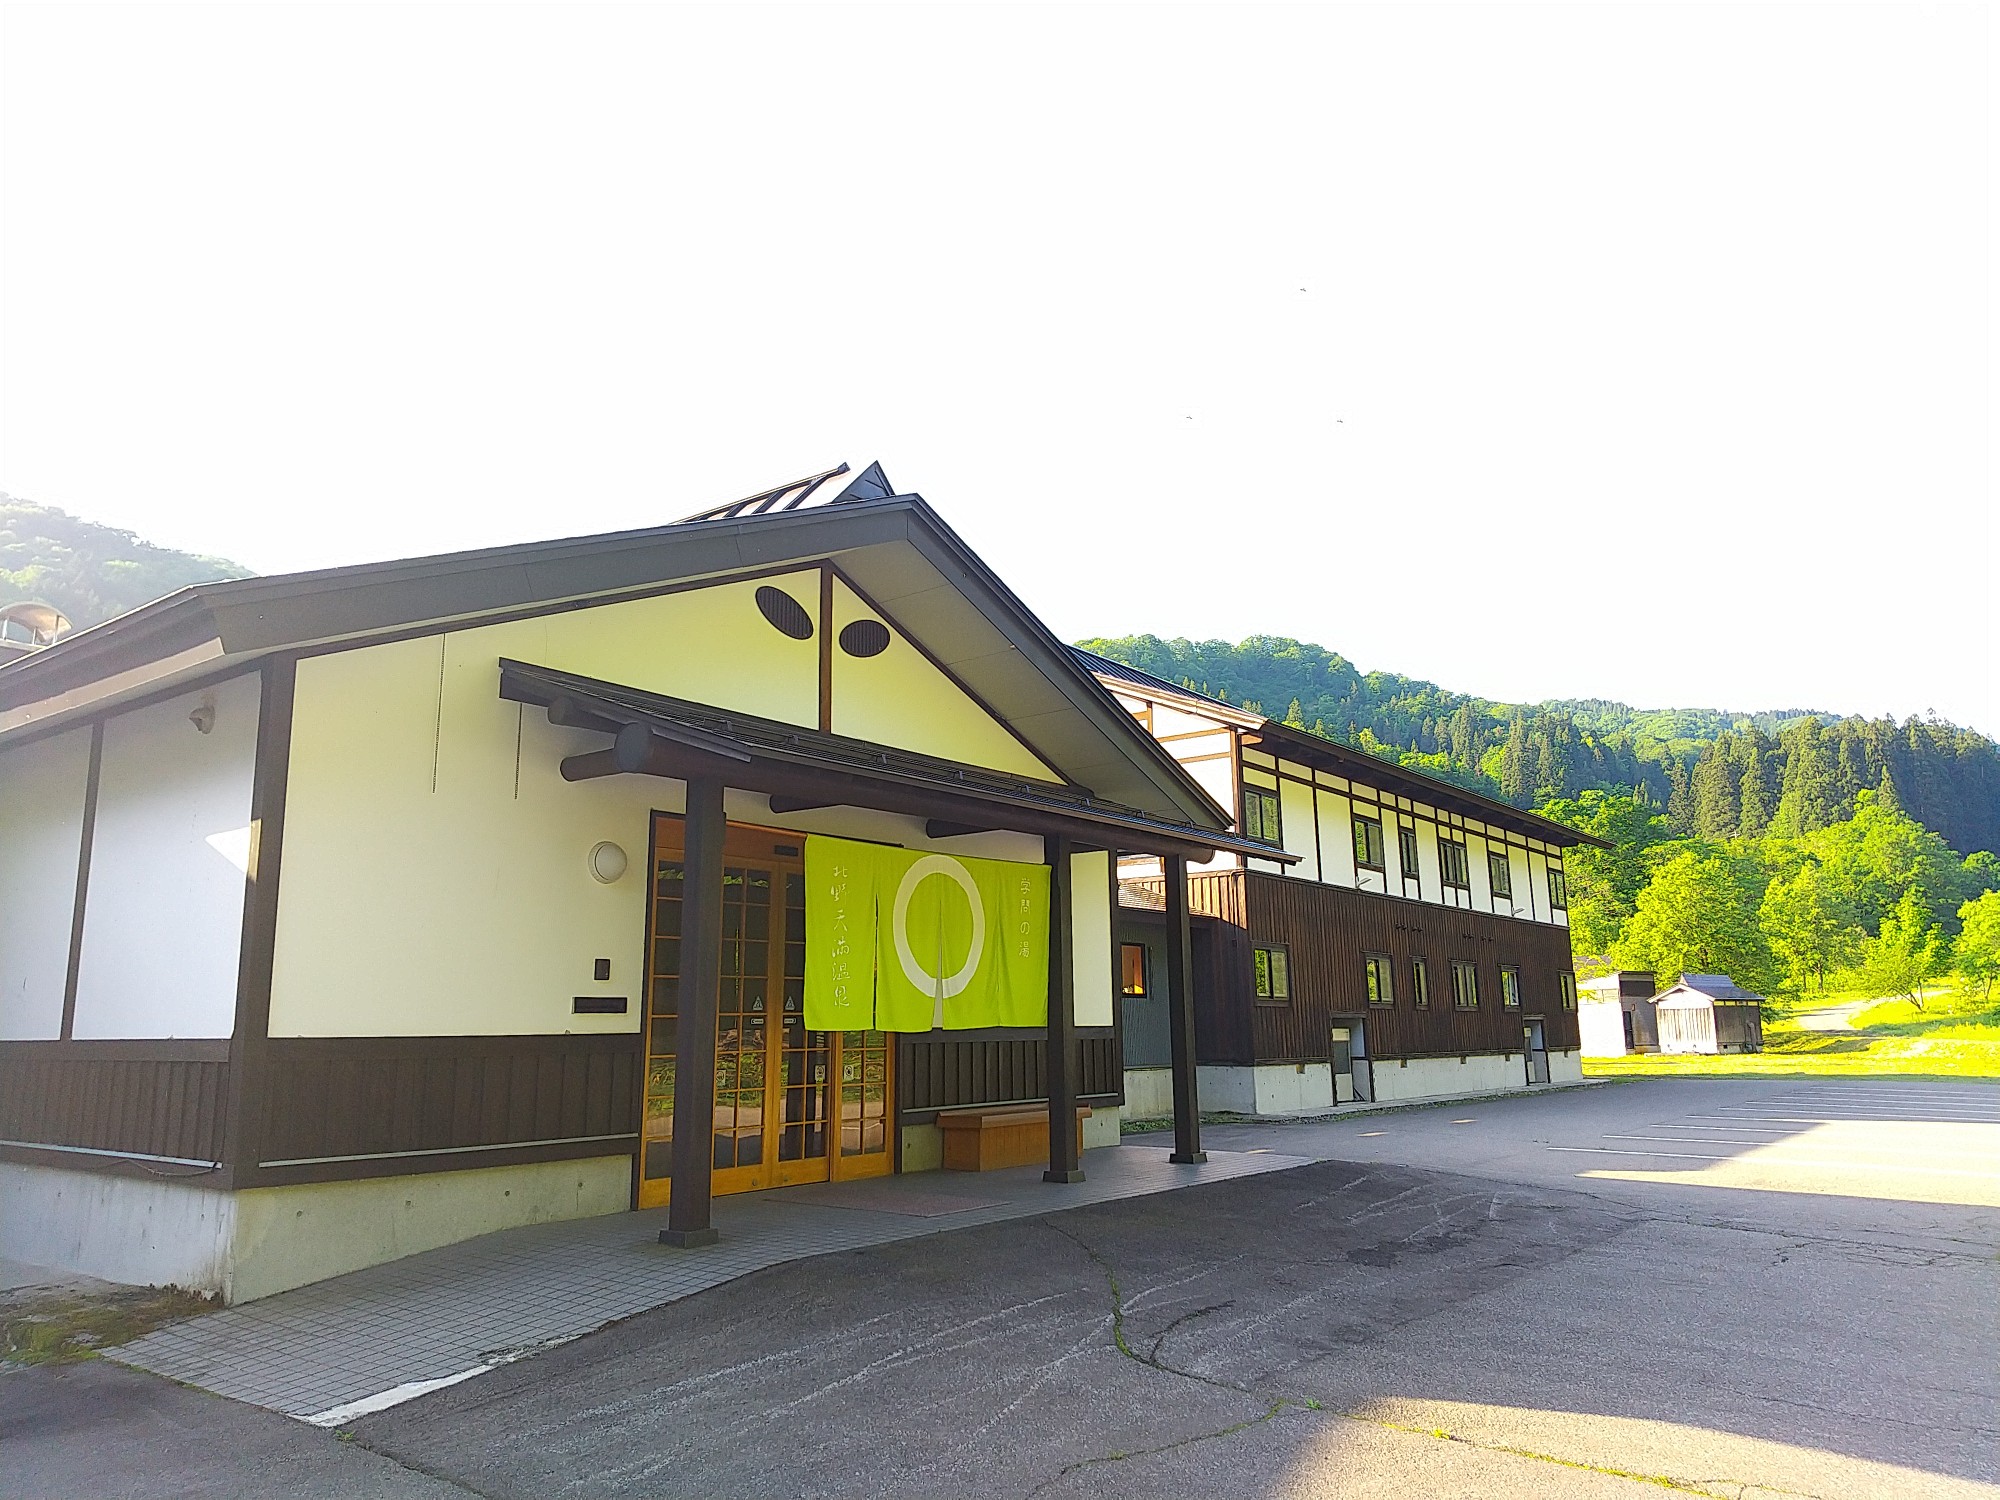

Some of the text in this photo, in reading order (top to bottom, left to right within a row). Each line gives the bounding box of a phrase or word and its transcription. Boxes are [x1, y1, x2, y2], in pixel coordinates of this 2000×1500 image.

[830, 865, 850, 1009] 北野天満温泉
[1019, 877, 1031, 958] 学問の湯
